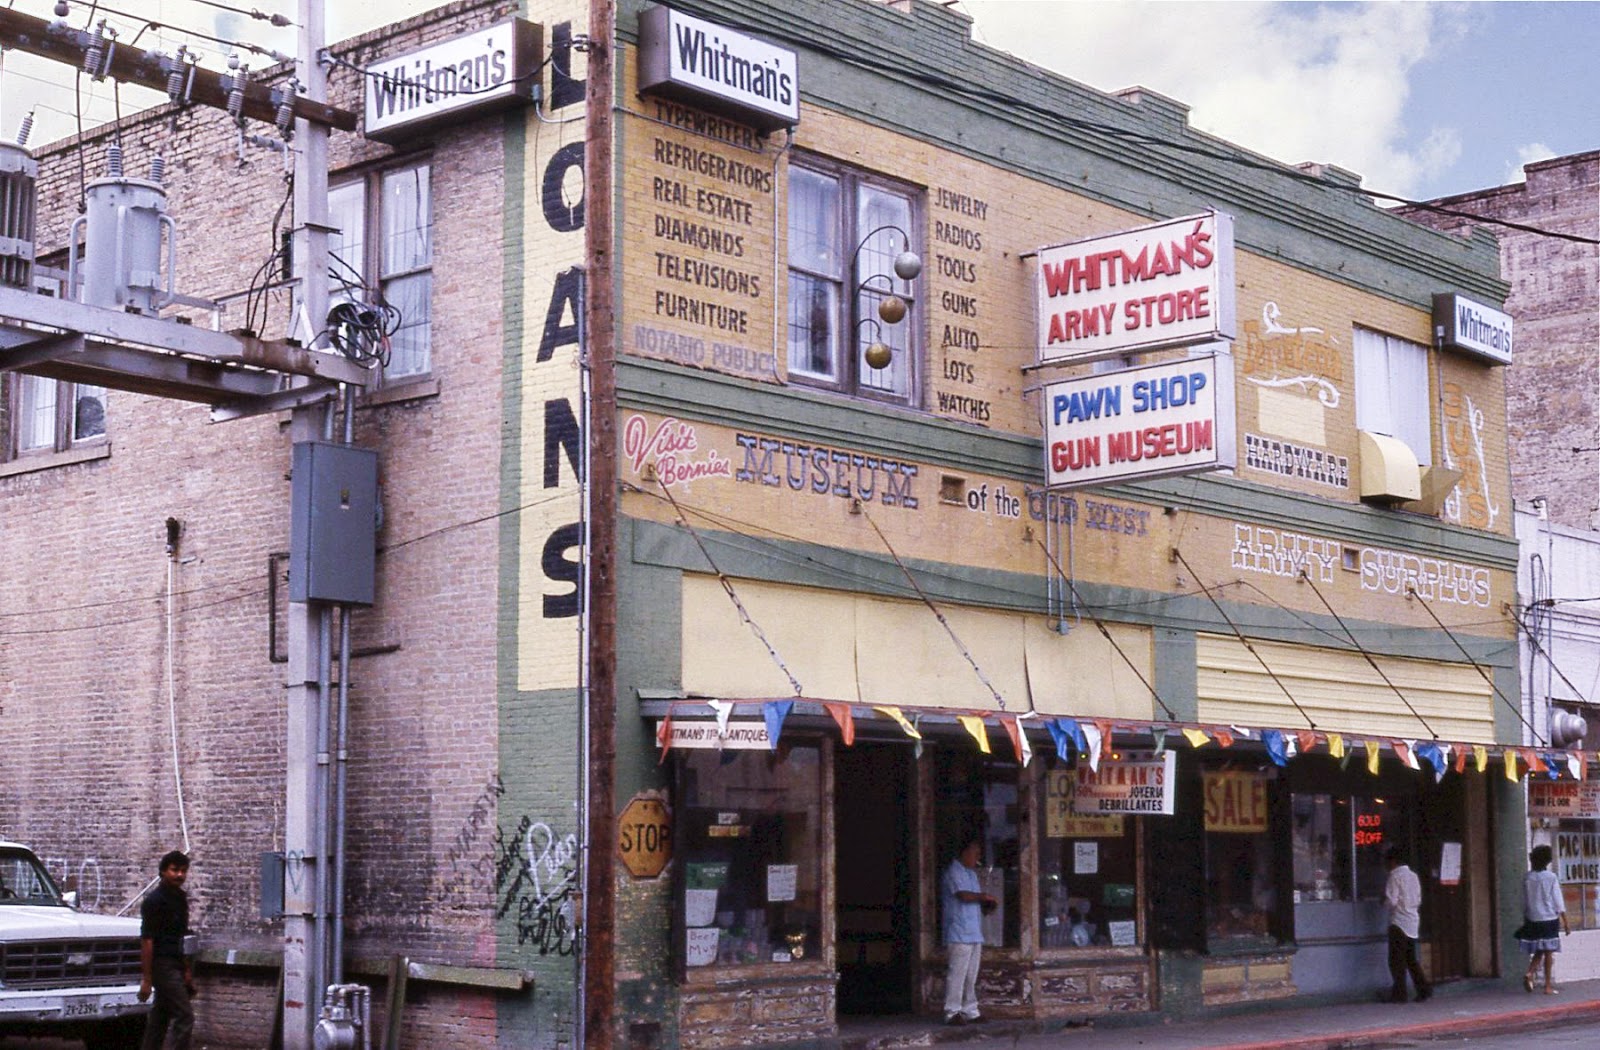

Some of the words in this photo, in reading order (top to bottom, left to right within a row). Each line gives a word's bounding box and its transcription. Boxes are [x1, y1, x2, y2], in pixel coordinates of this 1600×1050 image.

[373, 37, 506, 119] Whitman's
[675, 23, 792, 106] Whitman's
[655, 99, 763, 149] TYPEWRITERS
[655, 137, 772, 194] REFRIGERATORS
[653, 177, 691, 208] REAL
[697, 189, 753, 226] ESTATE
[934, 187, 988, 221] JEWELRY
[655, 214, 745, 258] DIAMONDS
[935, 220, 982, 251] RADIOS
[1043, 221, 1214, 298] WHITMAN'S
[655, 252, 761, 298] TELEVISIONS
[936, 254, 977, 284] TOOLS
[655, 291, 748, 335] FURNITURE
[941, 291, 977, 318] GUNS
[1047, 302, 1117, 345] ARMY
[1124, 286, 1212, 330] STORE
[1457, 303, 1511, 353] Whitman's
[634, 325, 706, 364] NOTARIO
[942, 325, 980, 351] AUTO
[943, 358, 975, 384] LOTS
[937, 391, 991, 422] WATCHES
[1053, 386, 1121, 427] PAWN
[1133, 371, 1207, 413] SHOP
[624, 413, 697, 472] Visit
[1051, 434, 1102, 474] GUN
[1107, 419, 1213, 463] MUSEUM
[1244, 433, 1349, 490] HARDWARE
[656, 450, 733, 487] Bernies
[735, 432, 919, 510] MUSEUM
[967, 484, 987, 512] of
[995, 486, 1021, 517] the
[1085, 500, 1151, 537] WEST
[1231, 523, 1340, 583] ARMY
[1359, 547, 1491, 608] SURPLUS
[1129, 786, 1163, 799] JOYERIA
[1203, 778, 1265, 826] SALE
[621, 823, 670, 853] STOP
[1565, 863, 1599, 881] LOUNGE
